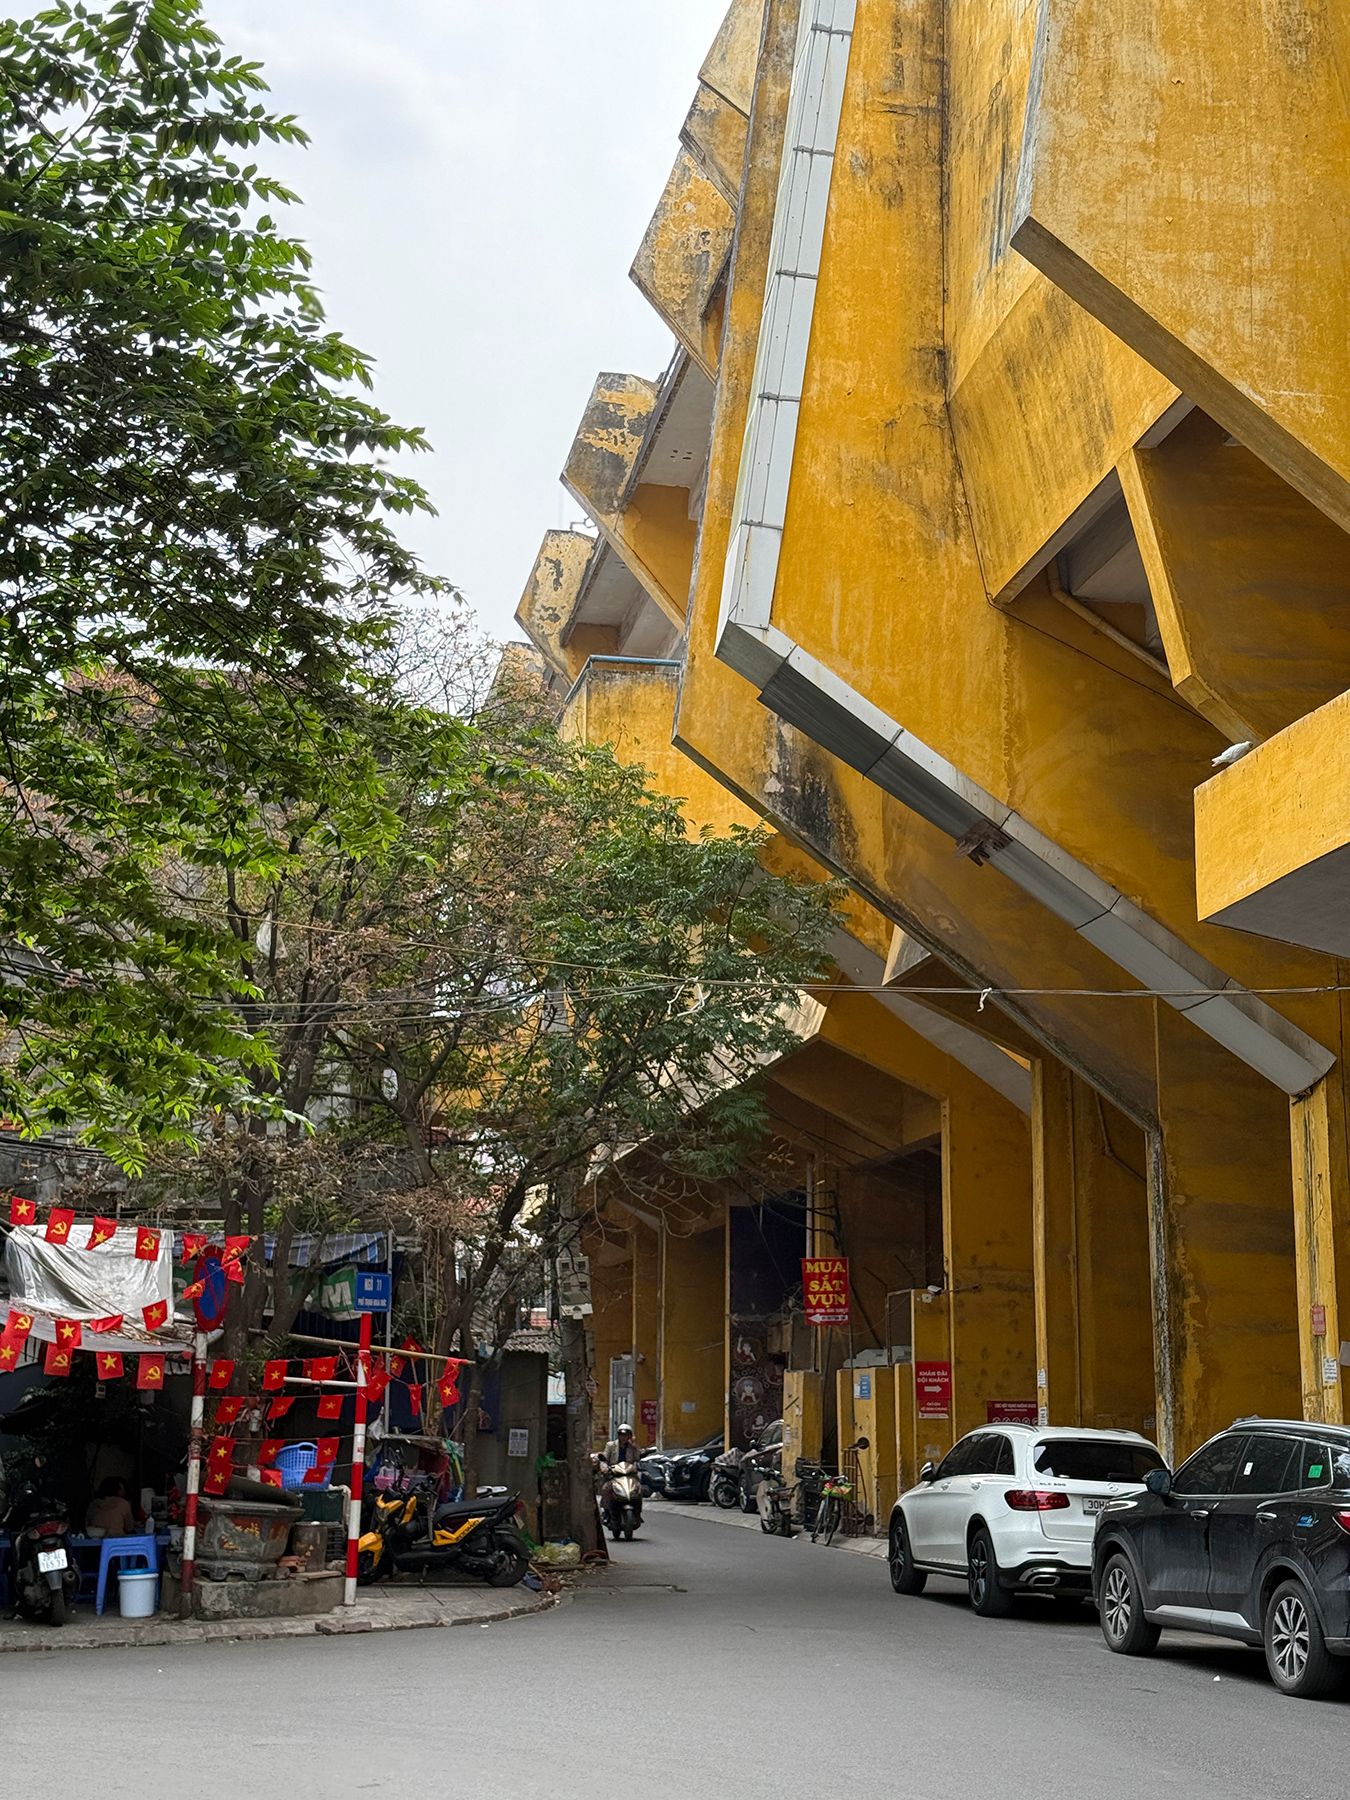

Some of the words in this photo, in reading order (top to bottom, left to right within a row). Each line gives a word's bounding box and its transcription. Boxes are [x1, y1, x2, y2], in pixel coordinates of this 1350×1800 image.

[805, 1261, 846, 1273] MUA
[808, 1274, 844, 1292] SẮT
[807, 1294, 846, 1308] VỤN
